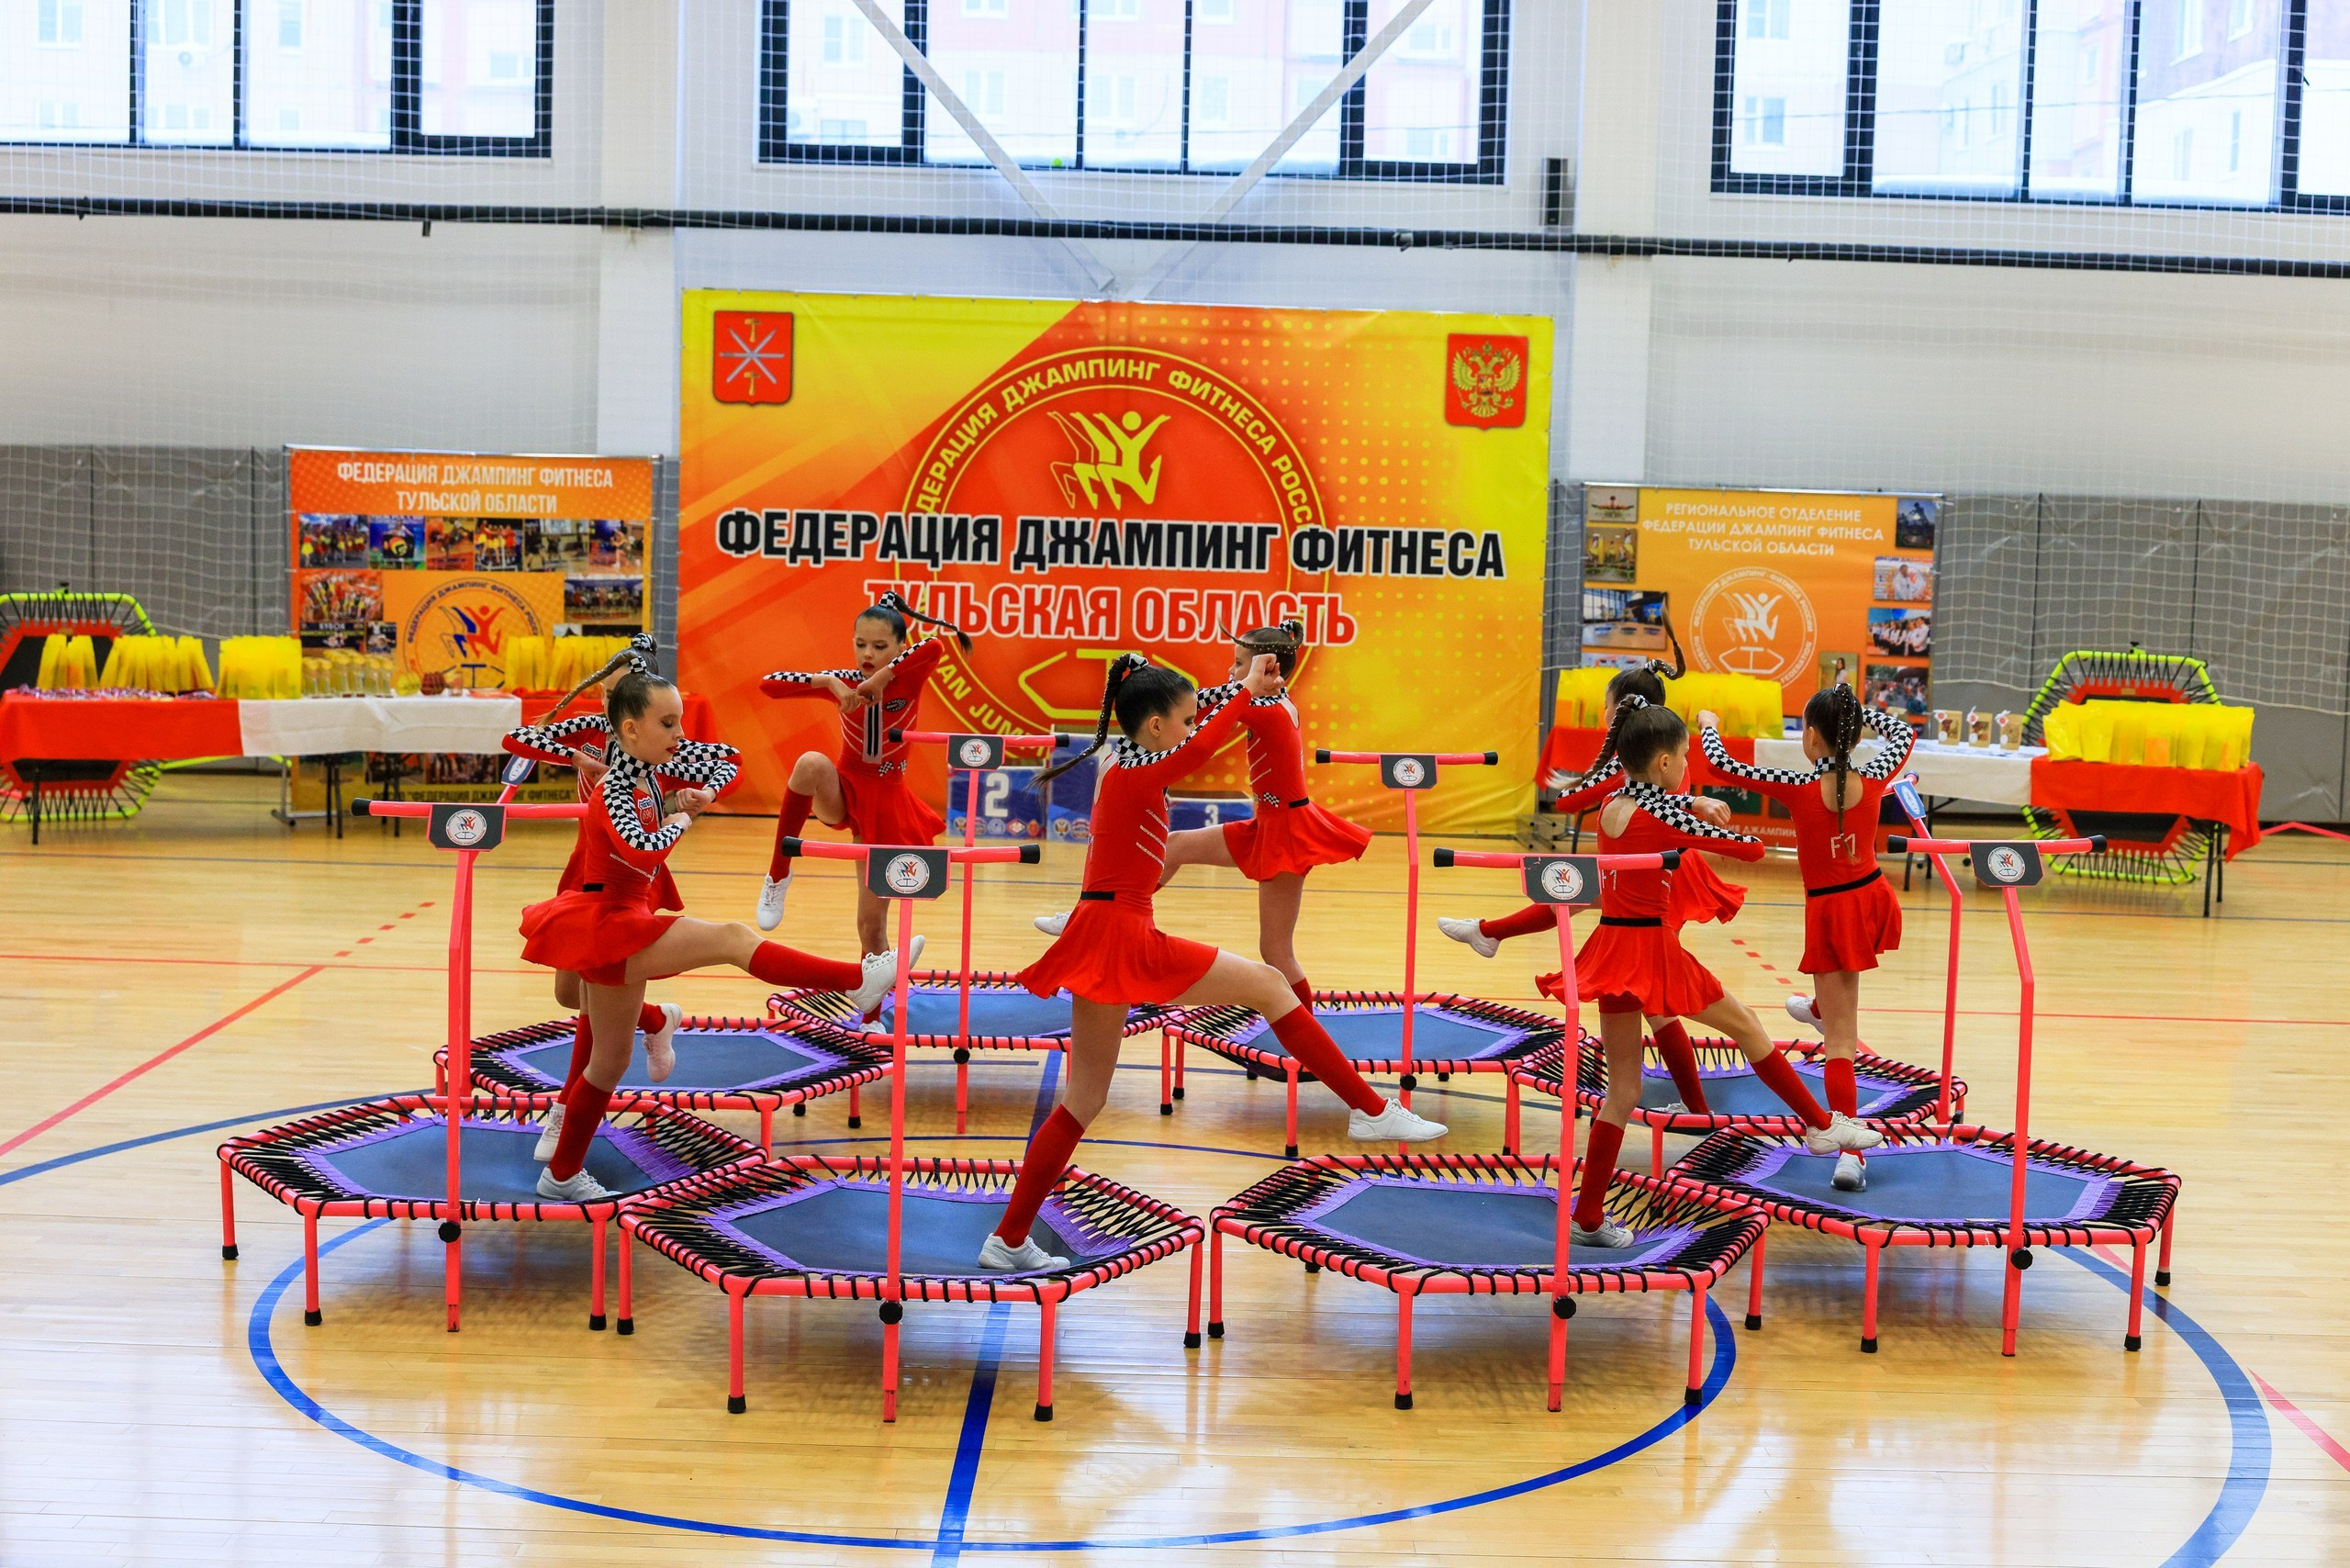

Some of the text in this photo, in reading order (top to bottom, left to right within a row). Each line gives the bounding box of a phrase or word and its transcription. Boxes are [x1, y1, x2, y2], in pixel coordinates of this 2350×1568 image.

[915, 402, 999, 514] ДЕРАЦИЯ
[1002, 358, 1160, 410] ДЖАМПИНГ
[1168, 369, 1277, 455] ФИТНЕСА
[337, 462, 613, 487] ФЕДЕРАЦИЯ ДЖАМПИНГ ФИТНЕСА
[397, 489, 557, 513] ТУЛЬСКОЙ ОБЛАСТИ
[1666, 502, 1862, 522] РЕГИОНАЛЬНОЕ ОТДЕЛЕНИЕ
[1642, 519, 1885, 541] ФЕДЕРАЦИИ ДЖАМПИНГ ФИТНЕСА
[717, 509, 1505, 579] ФЕДЕРАЦИЯ ДЖАМПИНГ ФИТНЕСА
[1688, 537, 1835, 556] ТУЛЬСКОЙ ОБЛАСТИ
[985, 773, 1010, 818] 2
[1204, 804, 1219, 826] 3
[1742, 825, 1796, 837] ДЖАМПИН
[1830, 833, 1856, 859] F1
